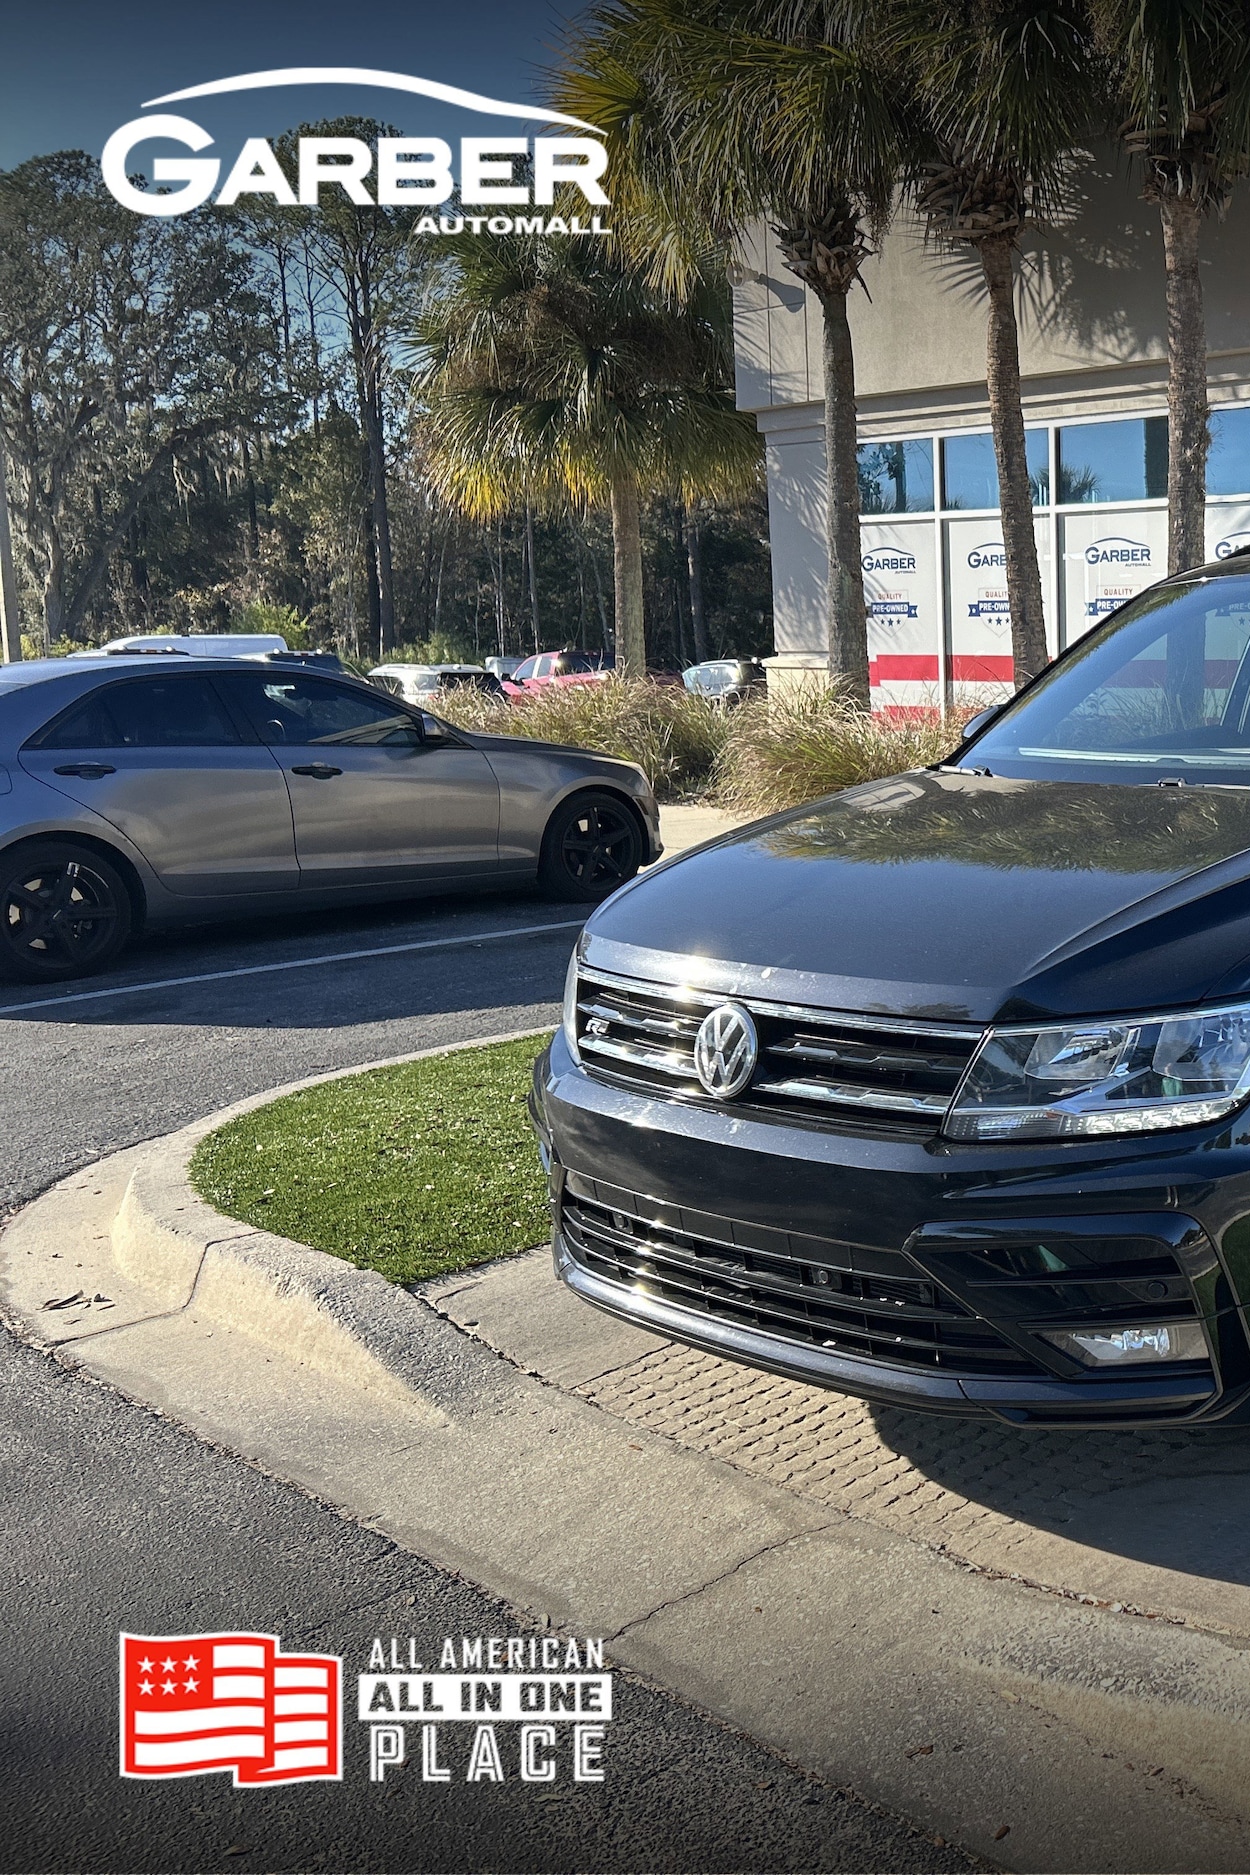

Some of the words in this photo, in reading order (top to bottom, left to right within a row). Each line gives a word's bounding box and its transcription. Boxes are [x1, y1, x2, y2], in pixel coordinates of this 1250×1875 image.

[1085, 546, 1151, 565] GARBER
[862, 555, 916, 573] GARBER
[1103, 588, 1133, 596] QUALITY
[872, 604, 909, 613] PRE-OWNED
